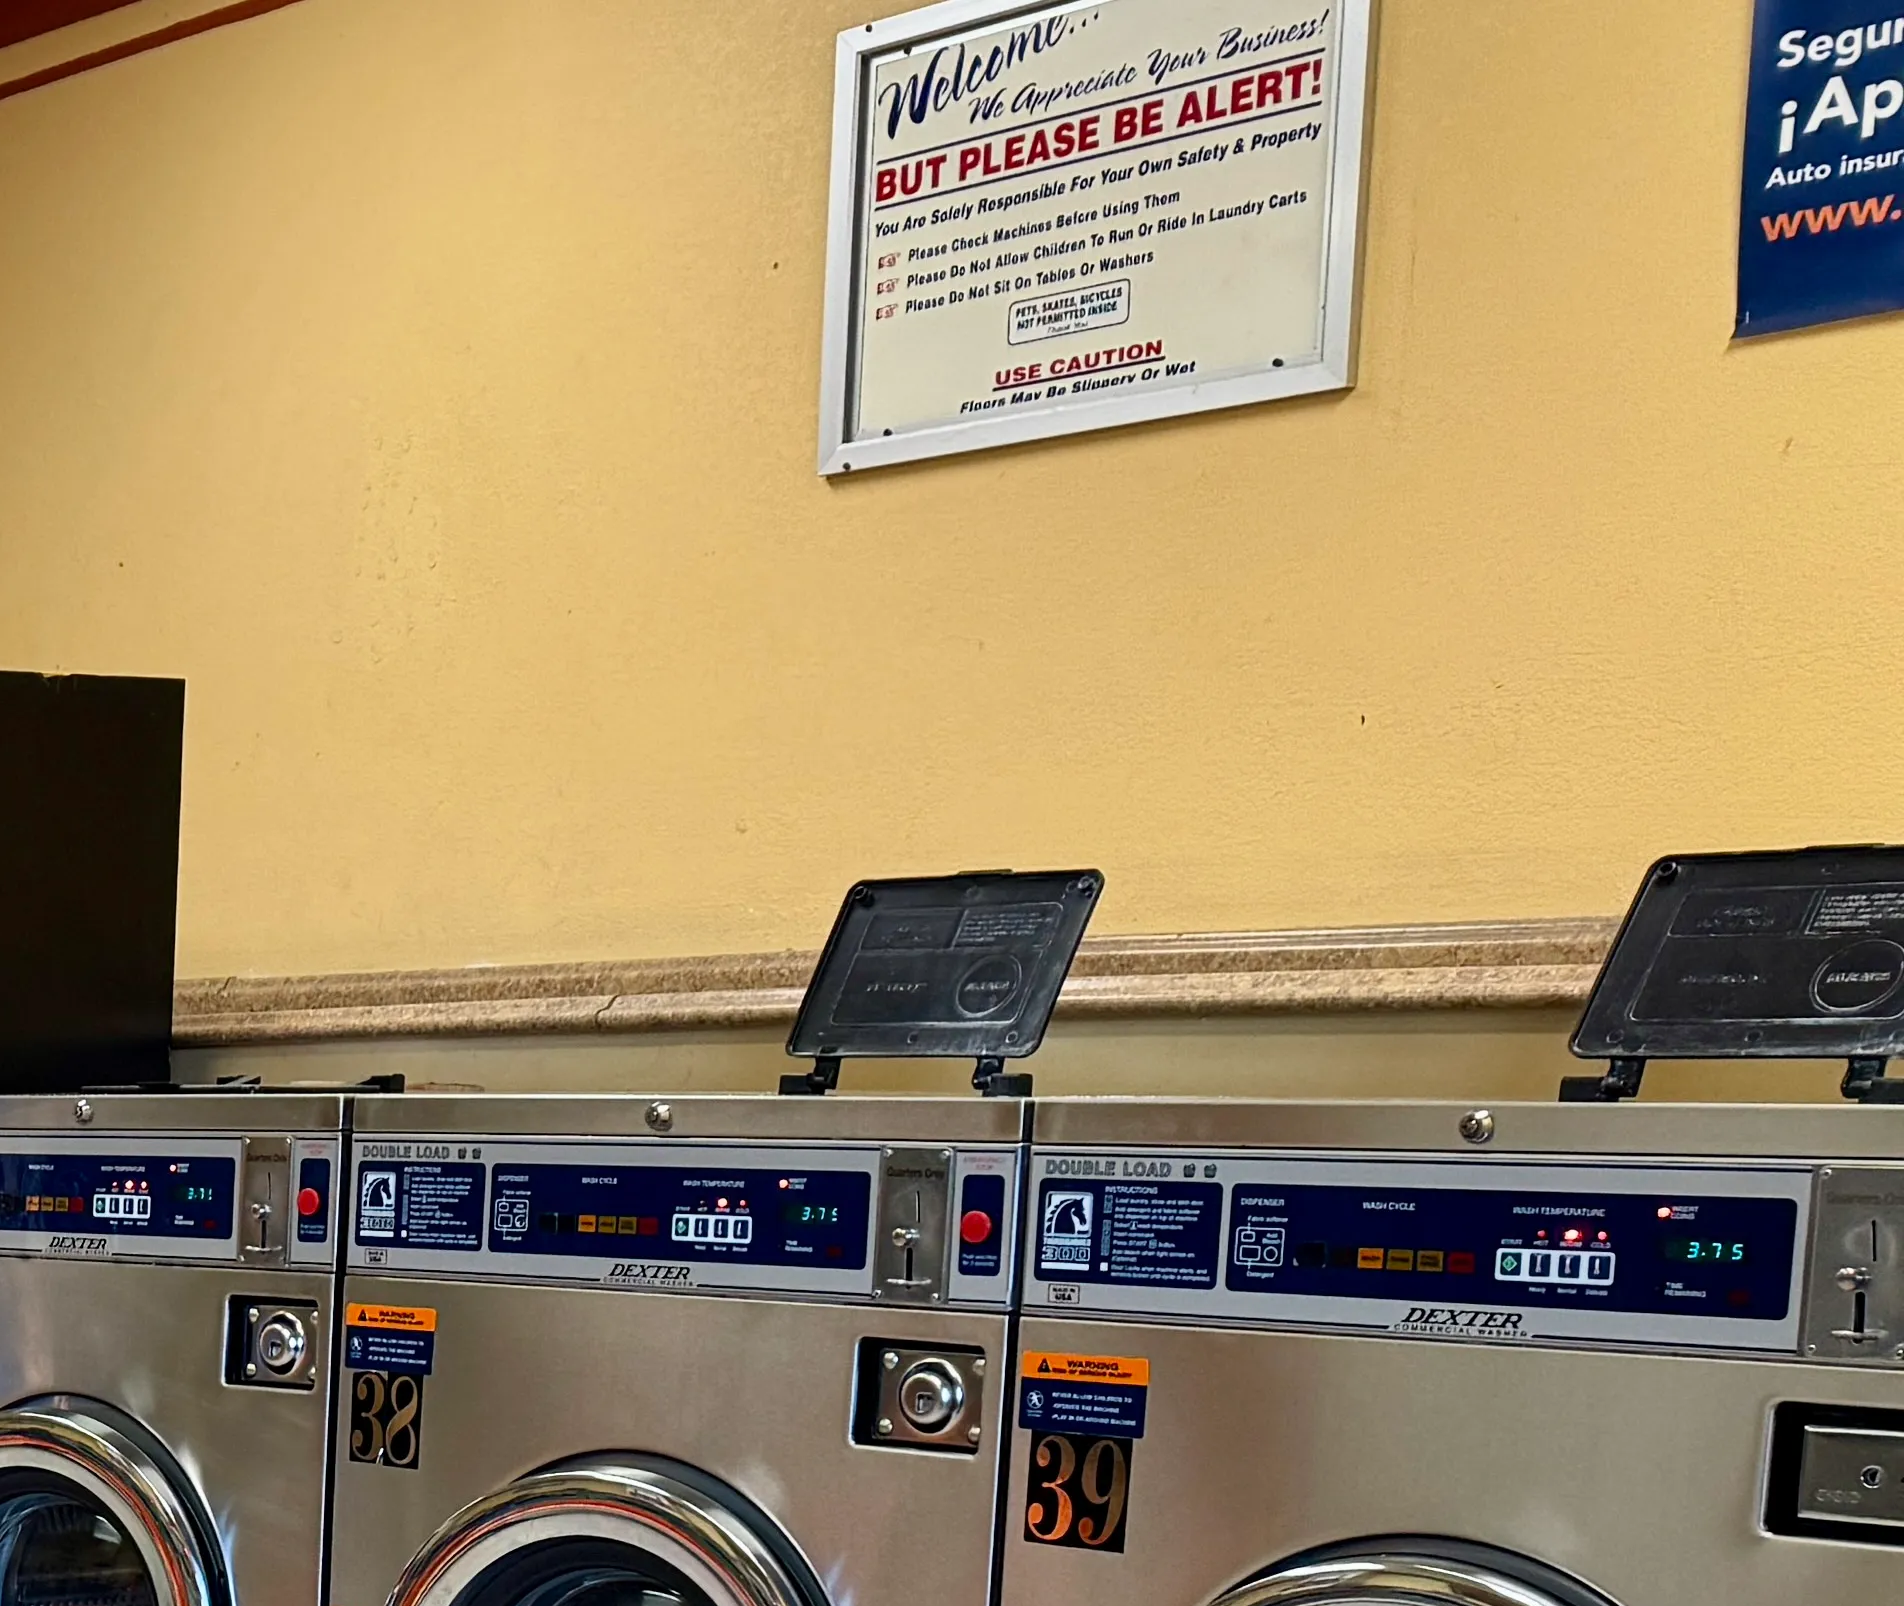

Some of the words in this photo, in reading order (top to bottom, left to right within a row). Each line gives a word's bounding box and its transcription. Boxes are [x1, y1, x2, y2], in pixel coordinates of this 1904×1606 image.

[968, 87, 1007, 124] We
[1011, 63, 1137, 115] Appreciate
[1147, 47, 1210, 85] Your
[1216, 9, 1329, 60] Business!
[875, 154, 948, 203] BUT
[959, 115, 1100, 182] PLEASE
[1114, 99, 1164, 144] BE
[1177, 58, 1323, 128] ALERT!
[874, 221, 899, 238] You
[903, 215, 927, 231] Are
[931, 203, 974, 226] Solely
[977, 180, 1065, 214] Responsible
[1070, 174, 1096, 192] For
[1101, 166, 1134, 185] Your
[1138, 157, 1173, 177] Own
[1177, 142, 1229, 168] Safety
[1232, 137, 1245, 155] &
[1251, 121, 1322, 151] Property
[1764, 162, 1832, 190] Auto
[1838, 149, 1904, 176] insur
[906, 269, 946, 288] Please
[950, 264, 966, 279] Do
[969, 258, 991, 274] Not
[995, 250, 1029, 268] Allow
[1033, 238, 1086, 259] Children
[1090, 233, 1104, 247] To
[1108, 228, 1134, 245] Run
[1138, 222, 1153, 237] Or
[1157, 216, 1187, 234] Ride
[1191, 211, 1205, 226] In
[1209, 199, 1265, 223] Laundry
[1268, 190, 1308, 209] Carts
[907, 244, 947, 262] Please
[951, 231, 989, 252] Check
[993, 220, 1052, 242] Machines
[1056, 210, 1098, 229] Before
[1102, 200, 1139, 219] Using
[1144, 191, 1180, 209] Them
[1761, 194, 1902, 242] www.
[905, 294, 945, 314] Please
[949, 289, 965, 304] Do
[968, 283, 990, 300] Not
[994, 278, 1010, 294] Sit
[1014, 274, 1031, 290] On
[1036, 266, 1076, 286] Tables
[1080, 261, 1096, 276] Or
[1100, 250, 1154, 273] Washers
[995, 363, 1042, 386] USE
[1050, 340, 1163, 375] CAUTION
[1141, 368, 1161, 381] Or
[1165, 360, 1196, 376] Wet
[362, 1144, 412, 1159] DOUBLE
[416, 1145, 450, 1160] LOAD
[1045, 1159, 1116, 1176] DOUBLE
[1123, 1161, 1172, 1178] LOAD
[1388, 1202, 1416, 1211] CYCLE
[48, 1236, 108, 1251] DEXTER
[1687, 1241, 1744, 1261] 3.75
[609, 1263, 691, 1280] DEXTER
[1393, 1323, 1473, 1335] COMMERCIAL
[1477, 1328, 1528, 1338] WASHER
[1401, 1307, 1523, 1330] DEXTER
[352, 1372, 419, 1465] 38
[1027, 1434, 1127, 1546] 39
